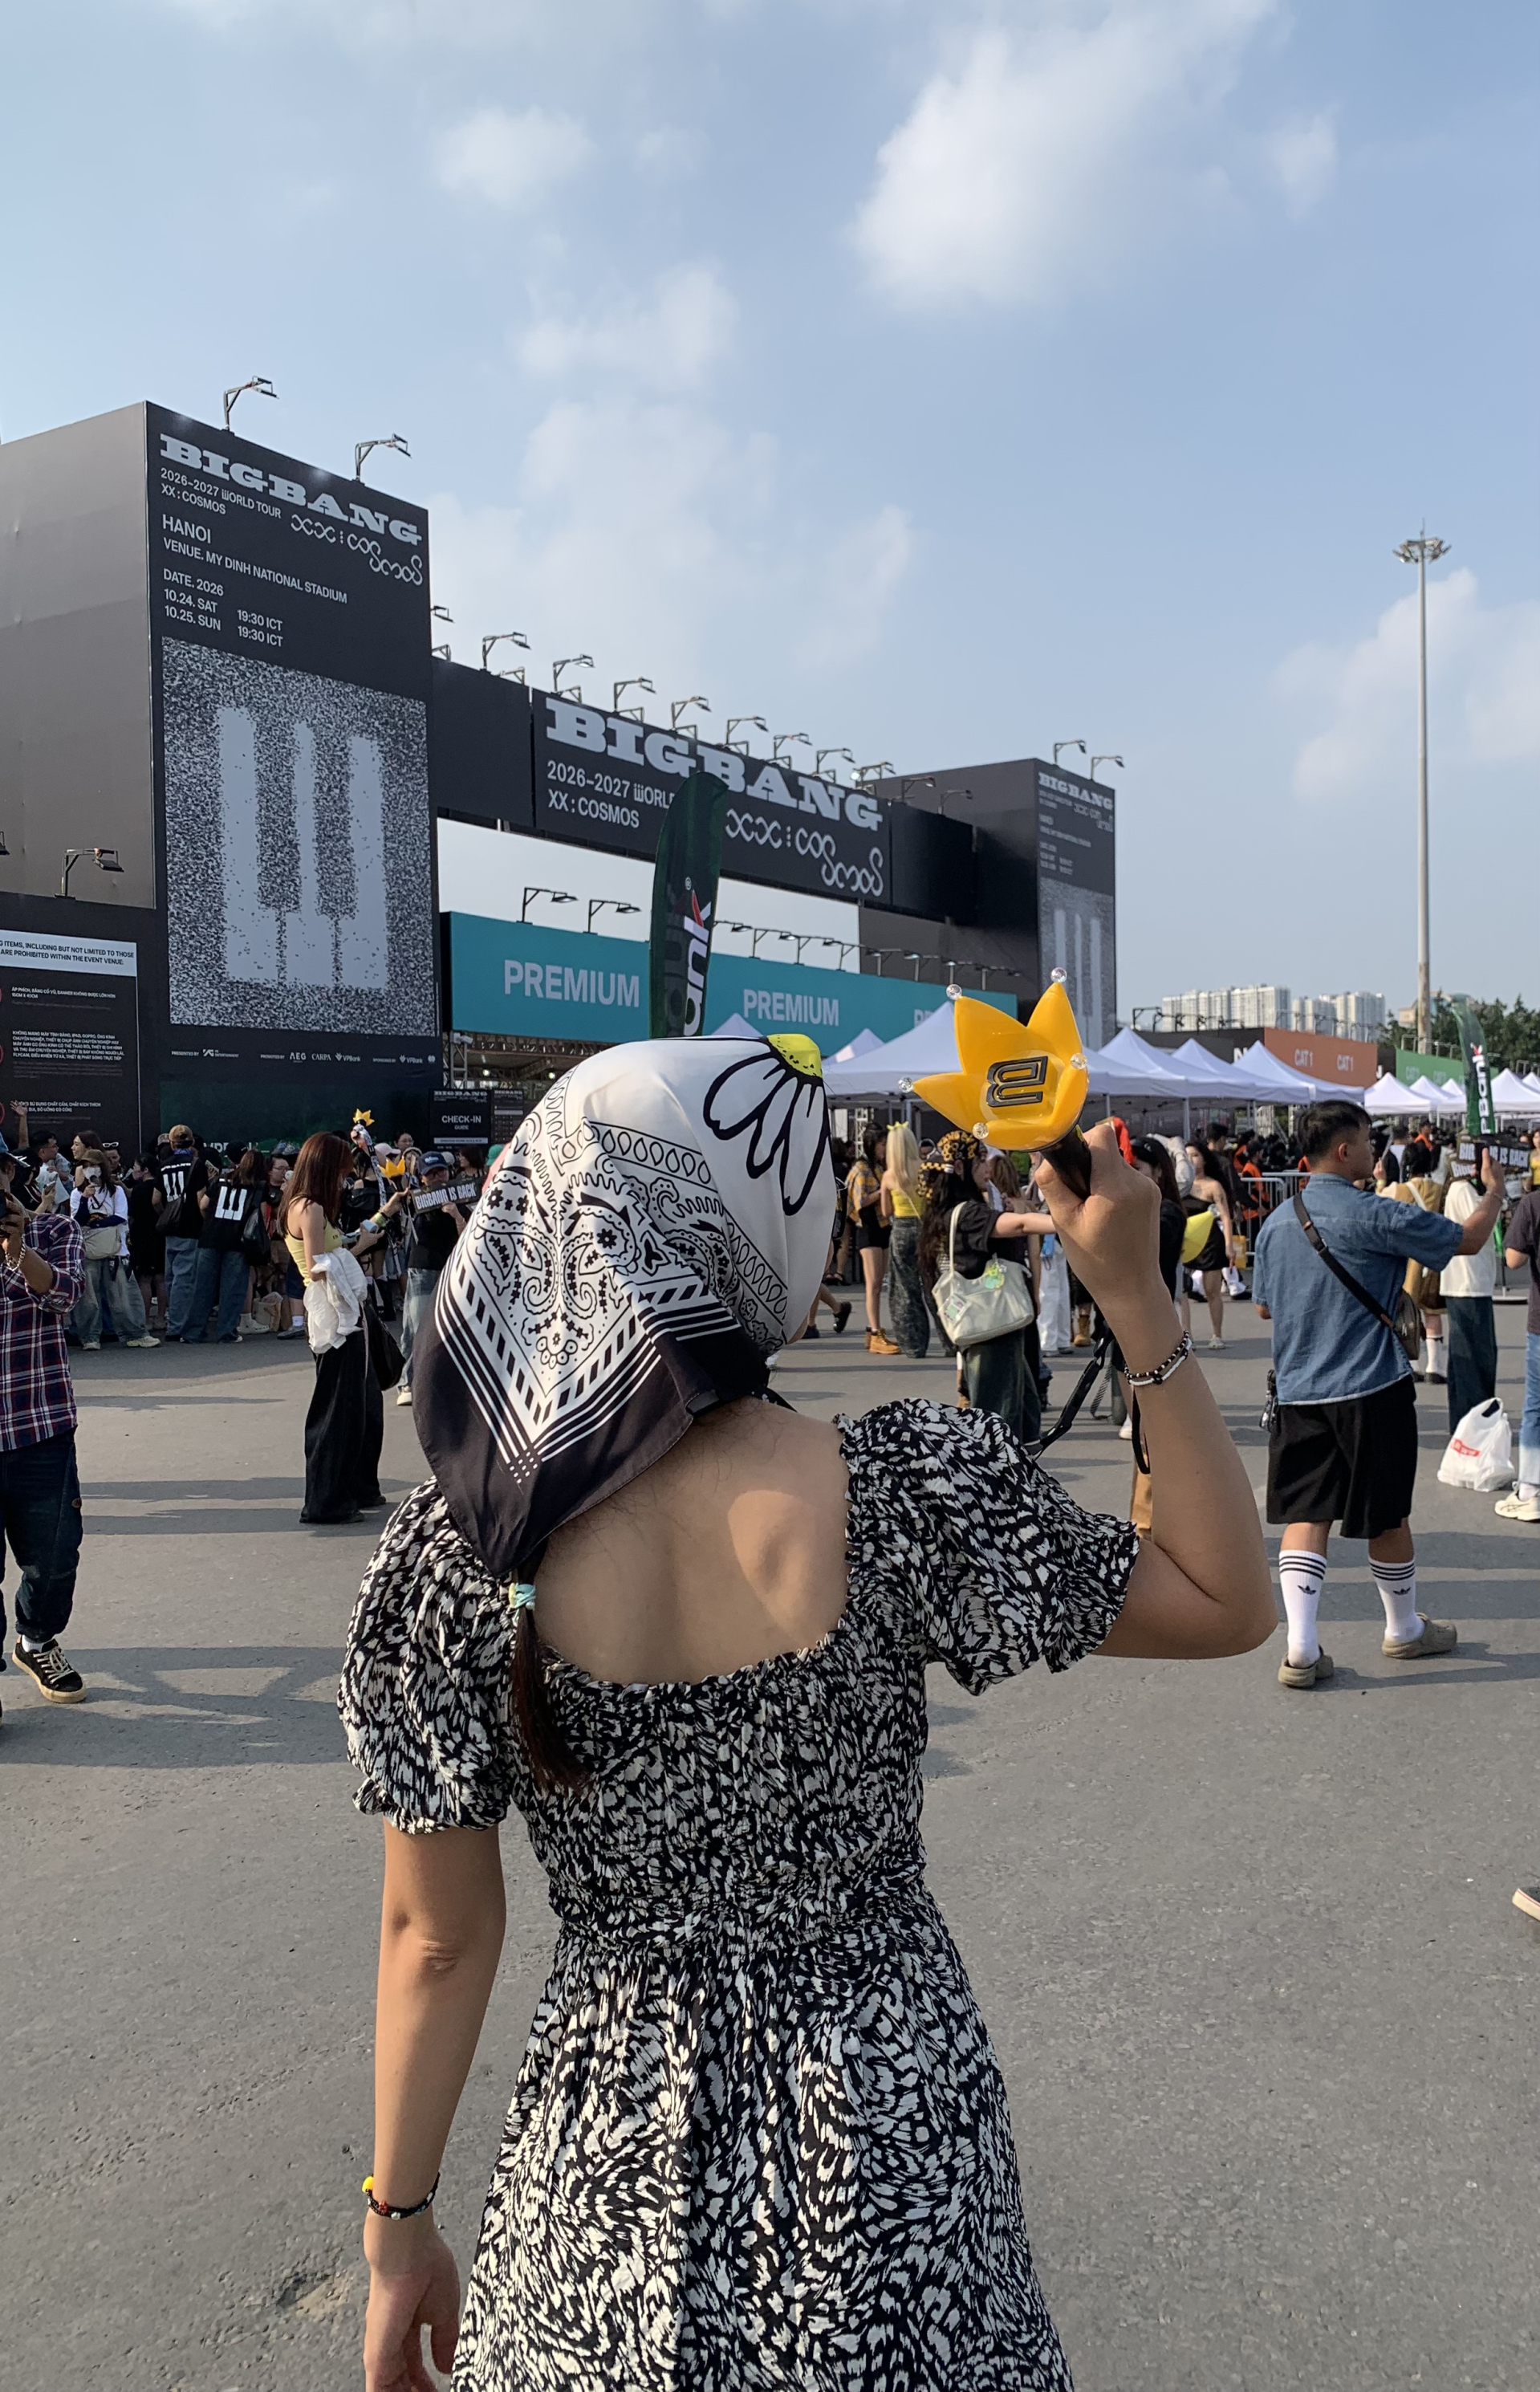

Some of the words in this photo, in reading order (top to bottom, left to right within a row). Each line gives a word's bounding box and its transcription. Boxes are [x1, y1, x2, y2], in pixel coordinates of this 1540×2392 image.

[161, 433, 422, 546] BIGBANG
[161, 467, 219, 497] 2026-2027
[256, 501, 282, 519] TOUR
[181, 490, 226, 515] COSMOS
[163, 515, 212, 543] HANOI
[163, 537, 204, 560] VENUE.
[206, 551, 223, 565] MY
[225, 556, 251, 576] DINH
[253, 565, 303, 591] NATIONAL
[304, 581, 348, 604] STADIUM
[163, 568, 194, 588] DATE.
[196, 579, 225, 596] 2026
[164, 588, 196, 608] 10.24.
[197, 598, 217, 613] SAT
[165, 604, 197, 624] 10.25.
[197, 615, 221, 631] SUN
[237, 609, 264, 626] 19:30
[266, 616, 283, 631] ICT
[238, 624, 265, 643] 19:30
[266, 632, 283, 647] ICT
[546, 697, 884, 832] BIGBANG
[547, 759, 631, 798] 2026-2027
[1038, 771, 1114, 811] BIGBANG
[578, 796, 640, 829] COSMOS
[14, 950, 49, 958] PROHIBITED
[50, 953, 71, 961] WITHIN
[25, 942, 57, 951] INCLUDING
[504, 958, 640, 1008] PREMIUM
[743, 988, 839, 1027] PREMIUM
[290, 1052, 307, 1060] AEG
[311, 1053, 331, 1062] CARPA
[441, 1115, 482, 1124] CHECK-IN
[415, 1188, 449, 1210] BIGBANG
[448, 1186, 457, 1201] IS
[457, 1183, 477, 1199] BACK
